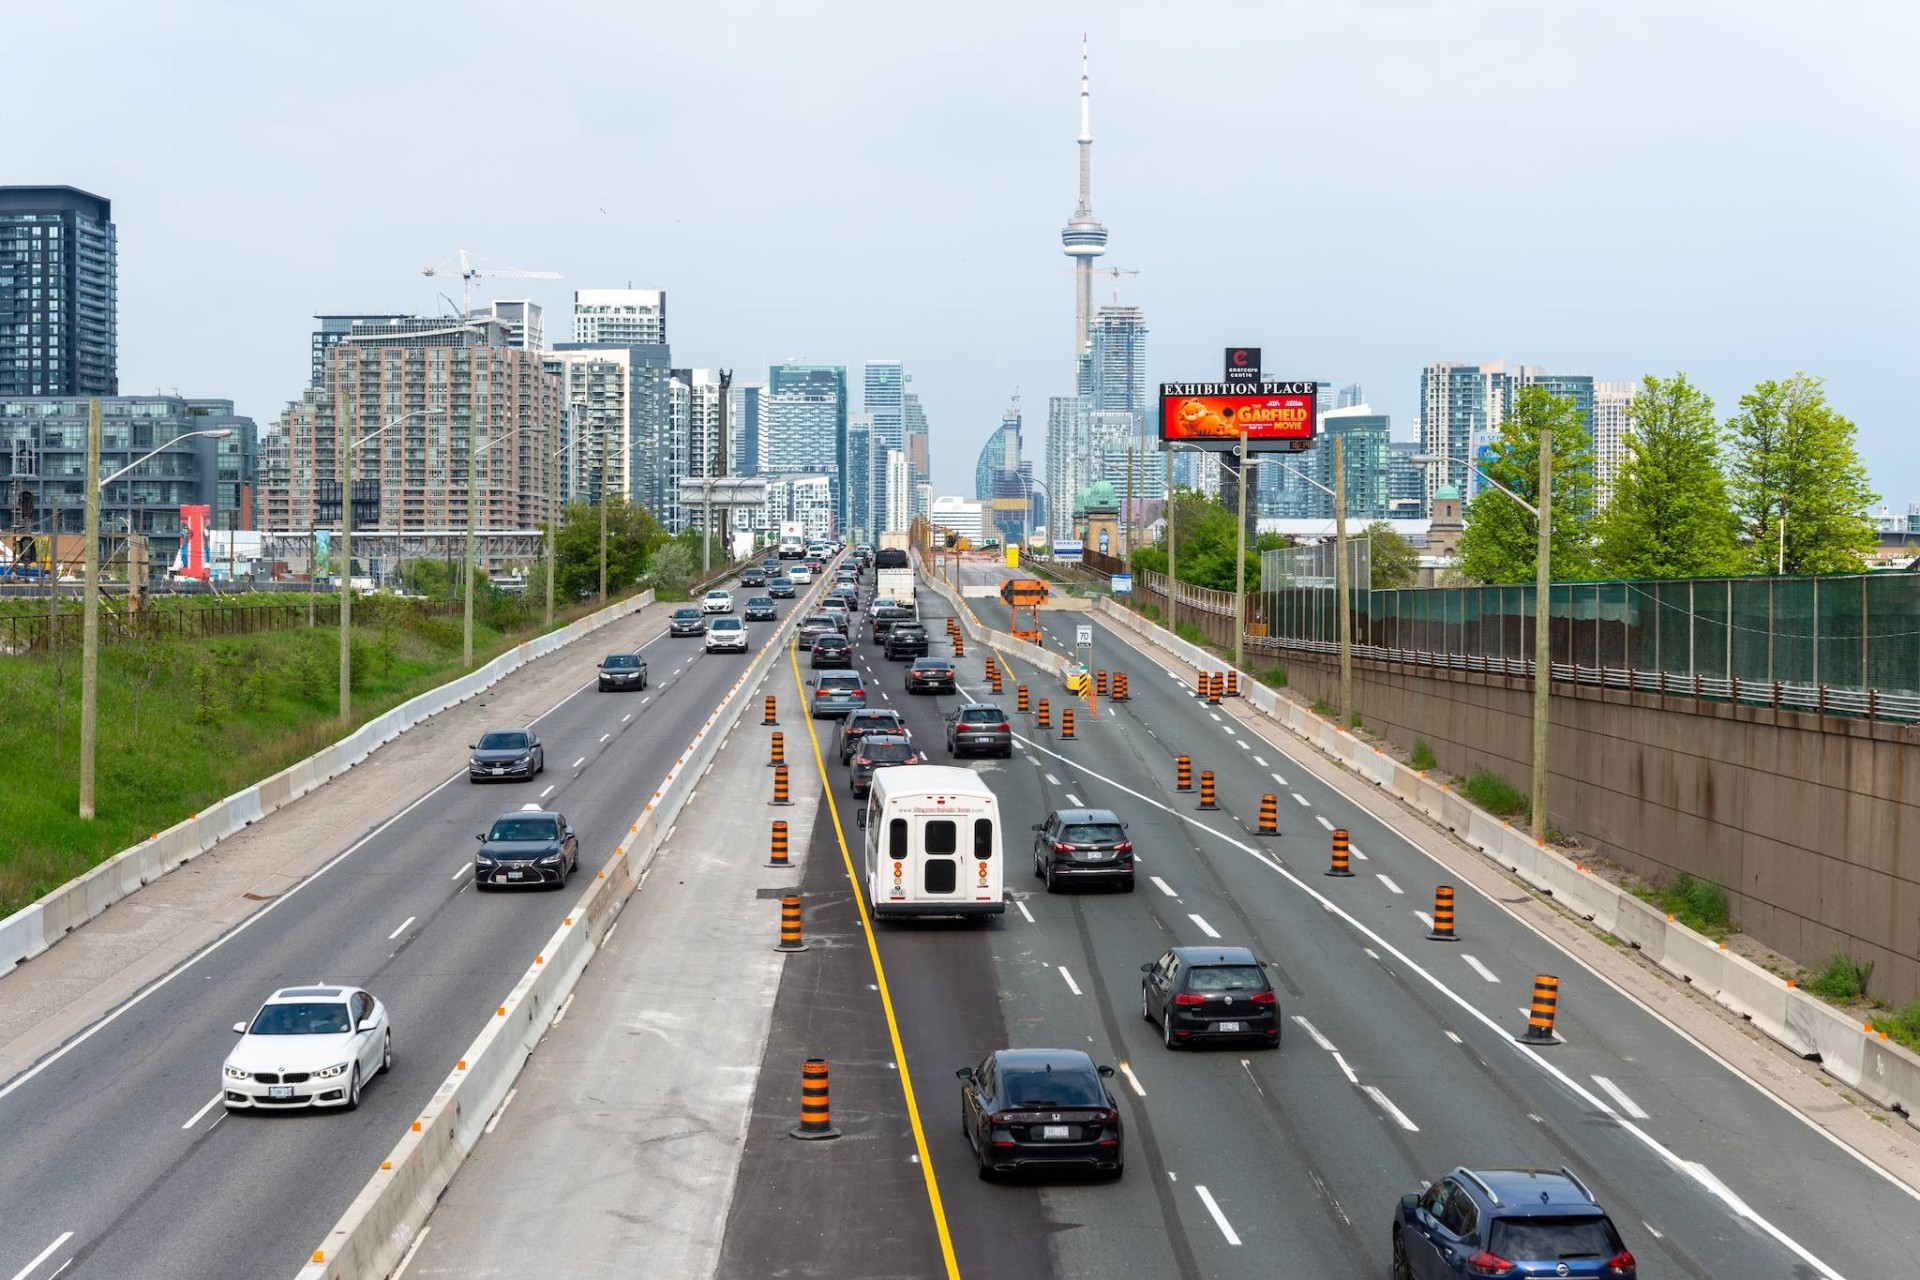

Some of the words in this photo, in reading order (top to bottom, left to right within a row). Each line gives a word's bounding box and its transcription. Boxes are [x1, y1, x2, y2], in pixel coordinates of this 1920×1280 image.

[1164, 383, 1257, 396] EXHIBITION
[1263, 382, 1313, 394] PLACE
[1238, 405, 1307, 423] GARFIELD
[1274, 422, 1302, 430] MOVIE
[1079, 631, 1089, 641] 70
